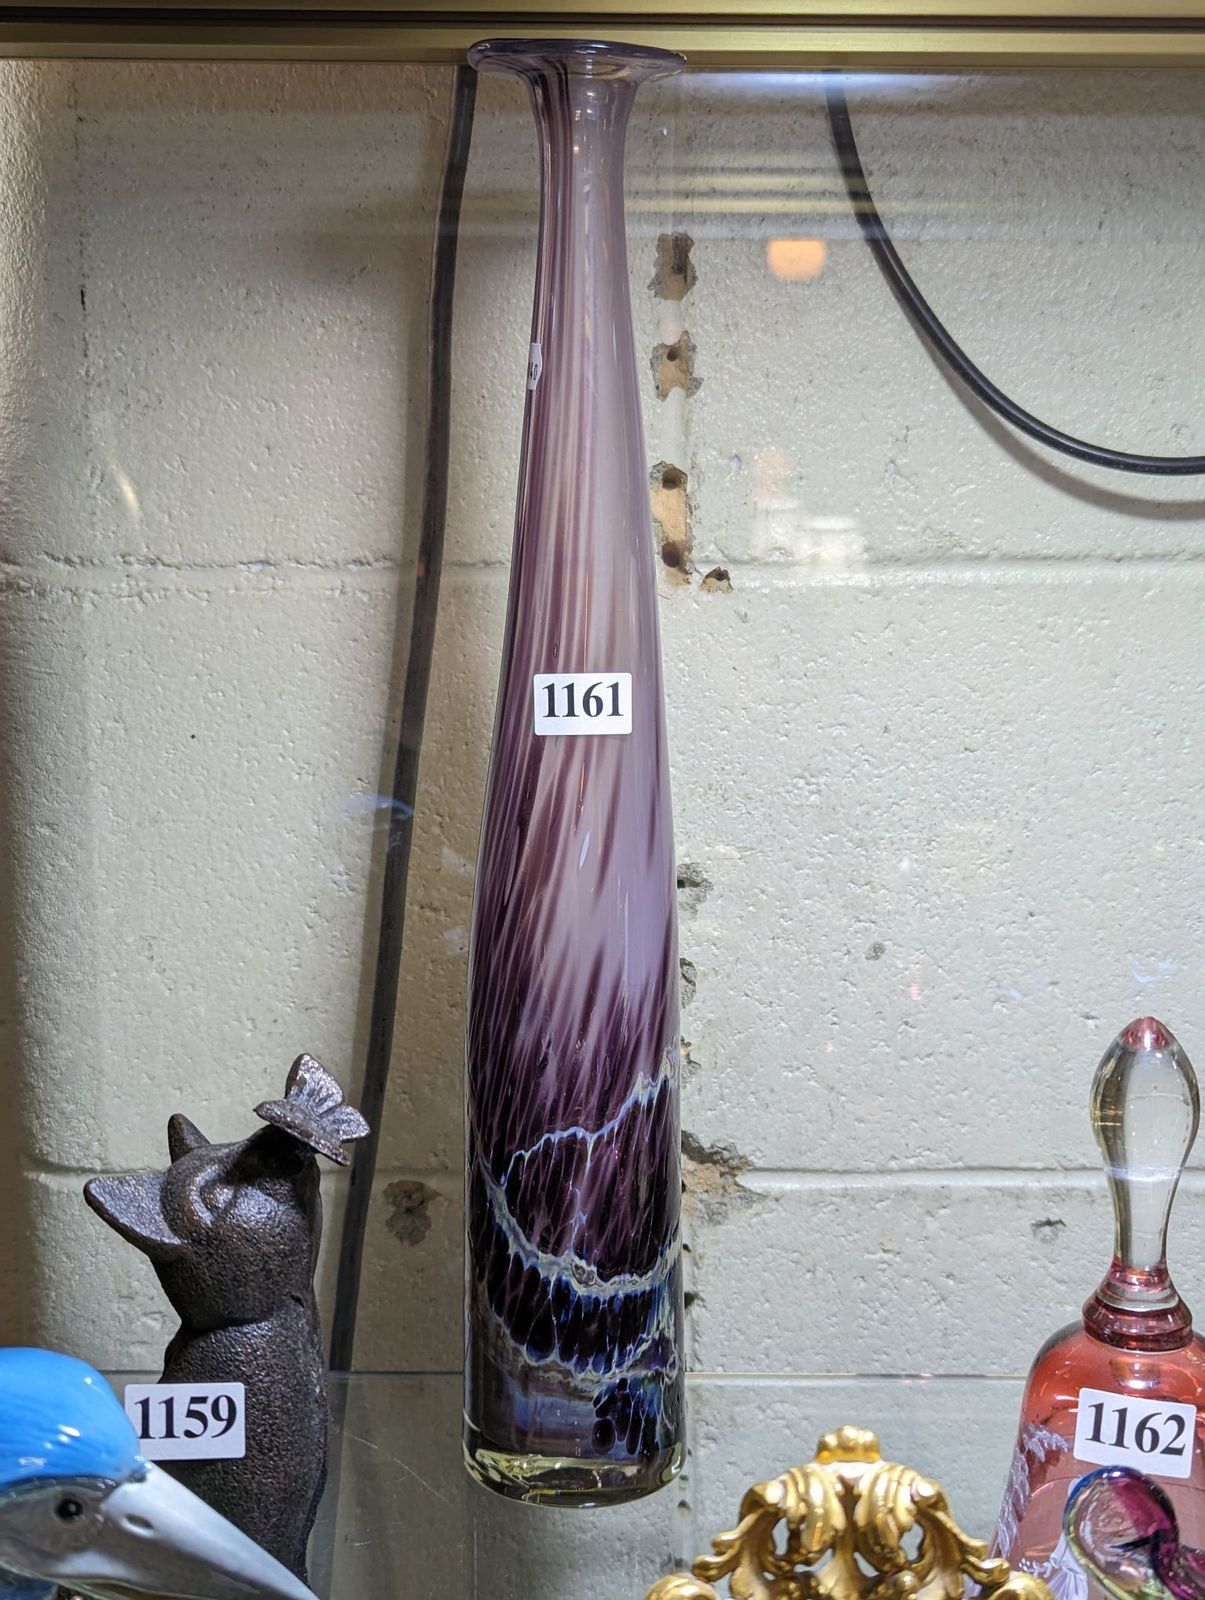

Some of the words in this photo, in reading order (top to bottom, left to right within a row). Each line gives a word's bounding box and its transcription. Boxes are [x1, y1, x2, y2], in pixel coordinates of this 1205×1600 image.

[542, 681, 624, 718] 1161
[134, 1394, 237, 1440] 1159
[1084, 1402, 1187, 1457] 1162
